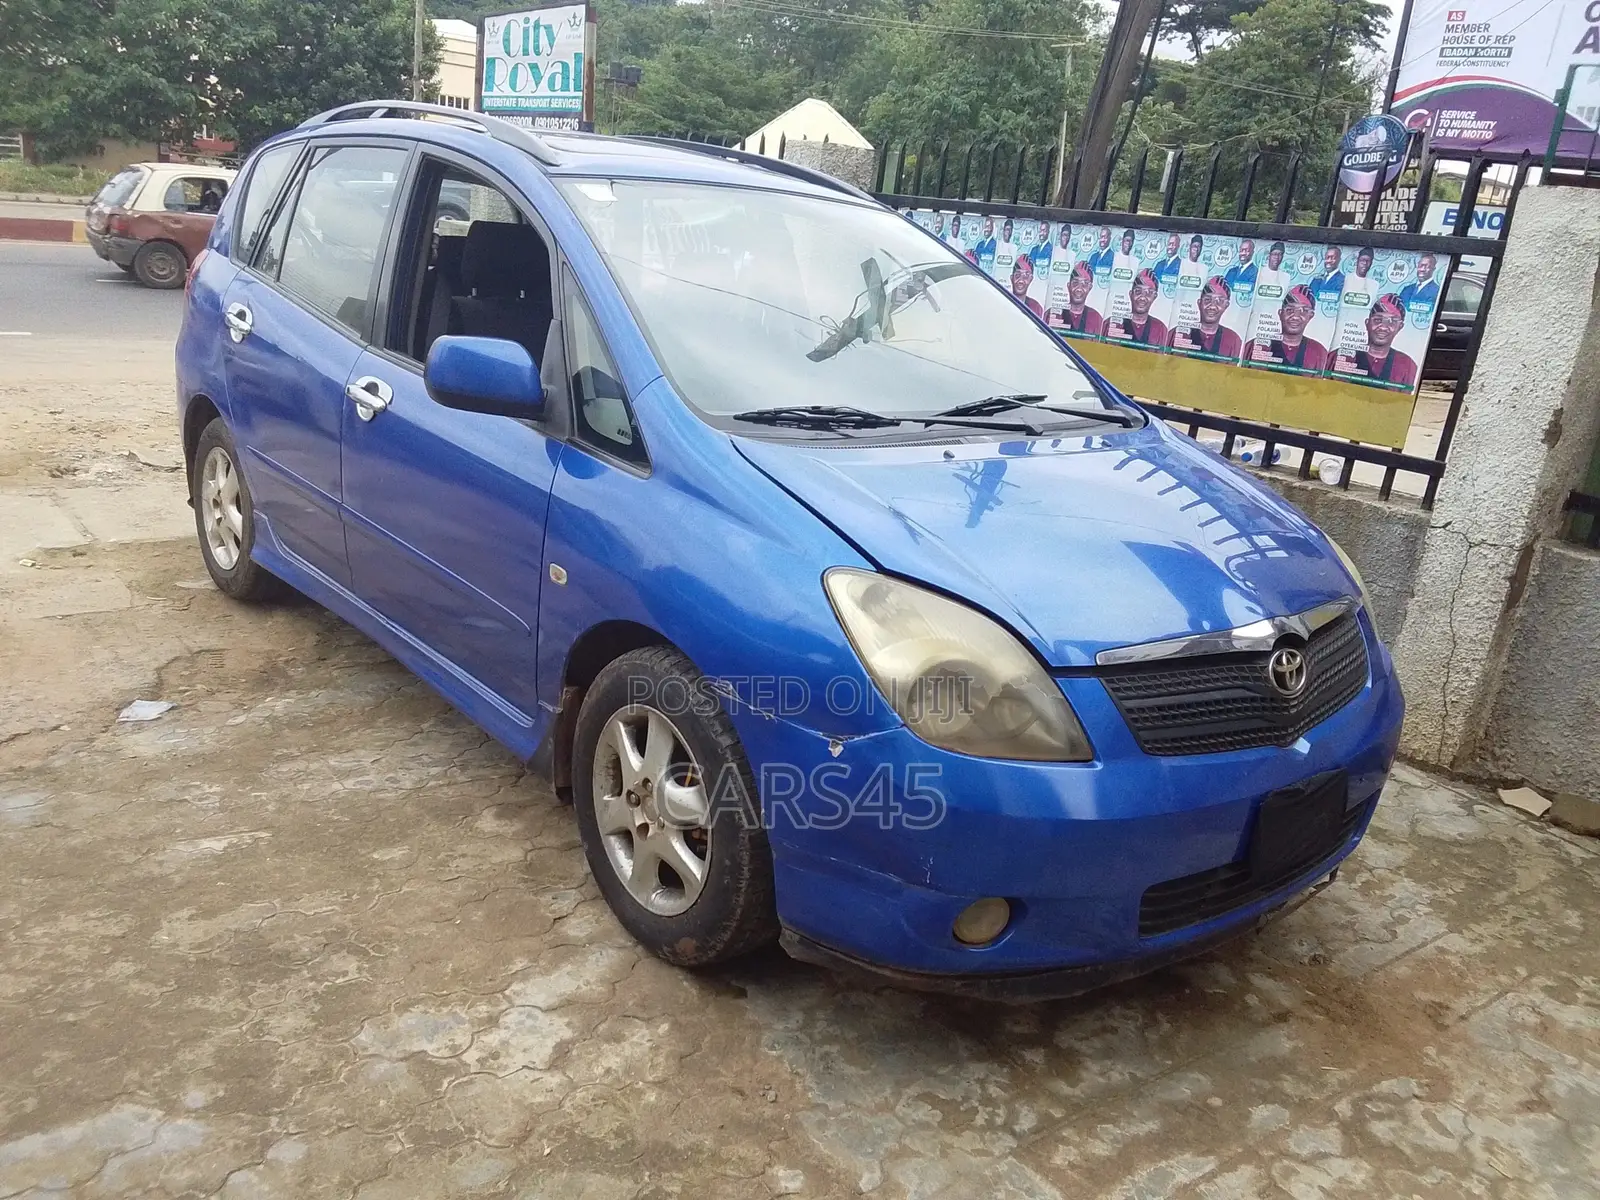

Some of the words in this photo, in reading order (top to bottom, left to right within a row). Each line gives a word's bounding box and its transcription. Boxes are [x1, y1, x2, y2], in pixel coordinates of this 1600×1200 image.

[1449, 11, 1464, 21] AS
[1444, 23, 1491, 34] MEMBER
[502, 16, 562, 58] City
[1441, 35, 1476, 45] HOUSE
[1477, 35, 1493, 45] OF
[1494, 35, 1516, 45] REP
[1442, 48, 1476, 57] IBADAN
[1476, 48, 1509, 57] NORTH
[1462, 60, 1511, 68] CONSTITUENCY
[484, 52, 583, 94] Royal
[518, 97, 550, 107] TRANSPORT
[1440, 110, 1477, 119] SERVICE
[1439, 119, 1450, 128] TO
[1451, 119, 1497, 130] HUMANITY
[1436, 128, 1446, 137] IS
[1446, 129, 1461, 138] MY
[1461, 130, 1493, 139] MOTTO
